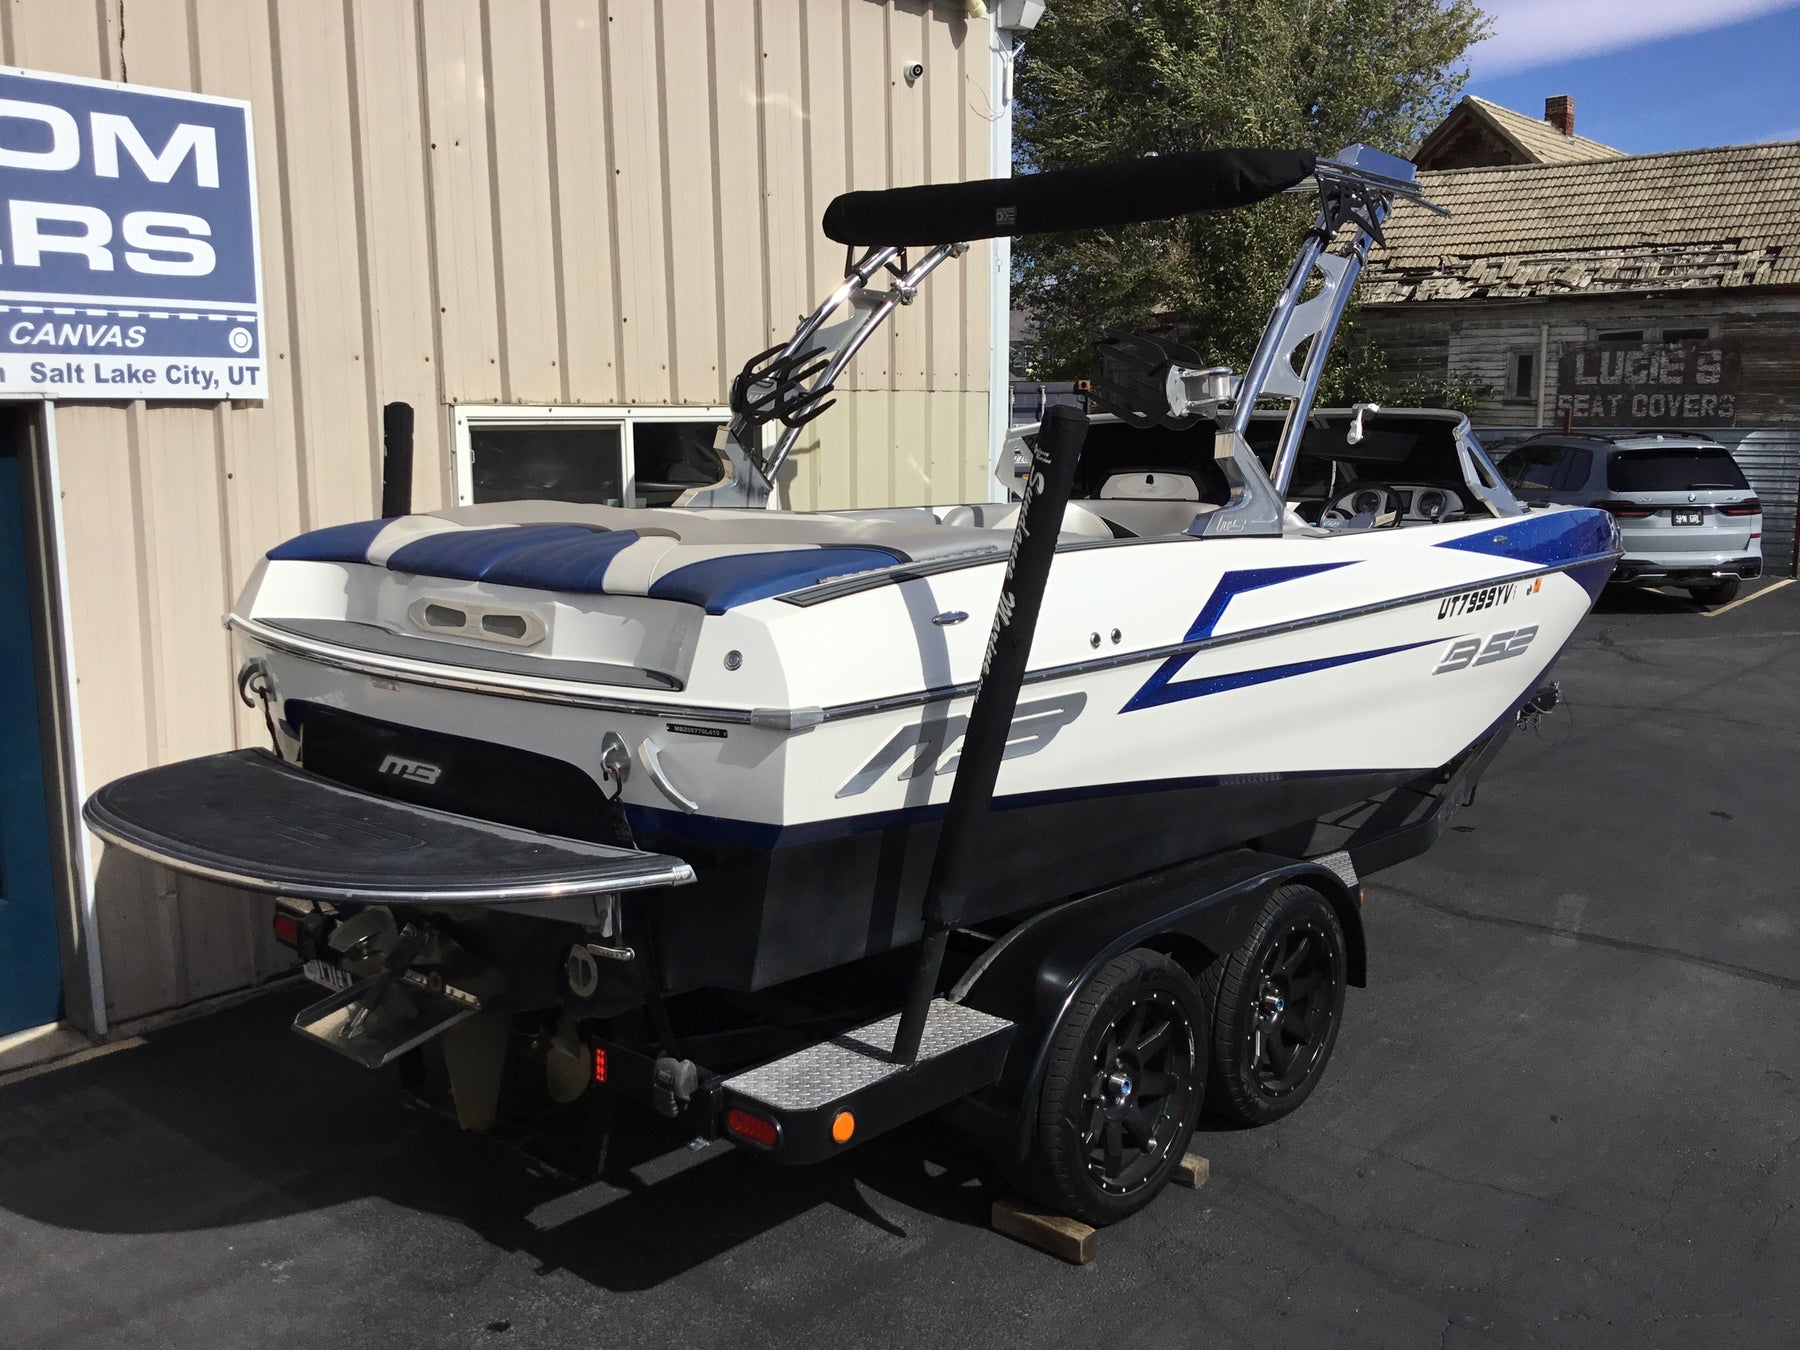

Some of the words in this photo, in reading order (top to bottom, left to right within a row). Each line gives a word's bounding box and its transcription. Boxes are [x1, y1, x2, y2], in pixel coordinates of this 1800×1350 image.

[0, 200, 216, 277] RS
[9, 321, 147, 348] CANVAS
[30, 361, 85, 385] Salt
[95, 363, 157, 385] Lake
[165, 364, 220, 390] City,
[228, 366, 261, 386] UT
[1557, 393, 1623, 418] SEAT
[1632, 392, 1737, 419] COVERS
